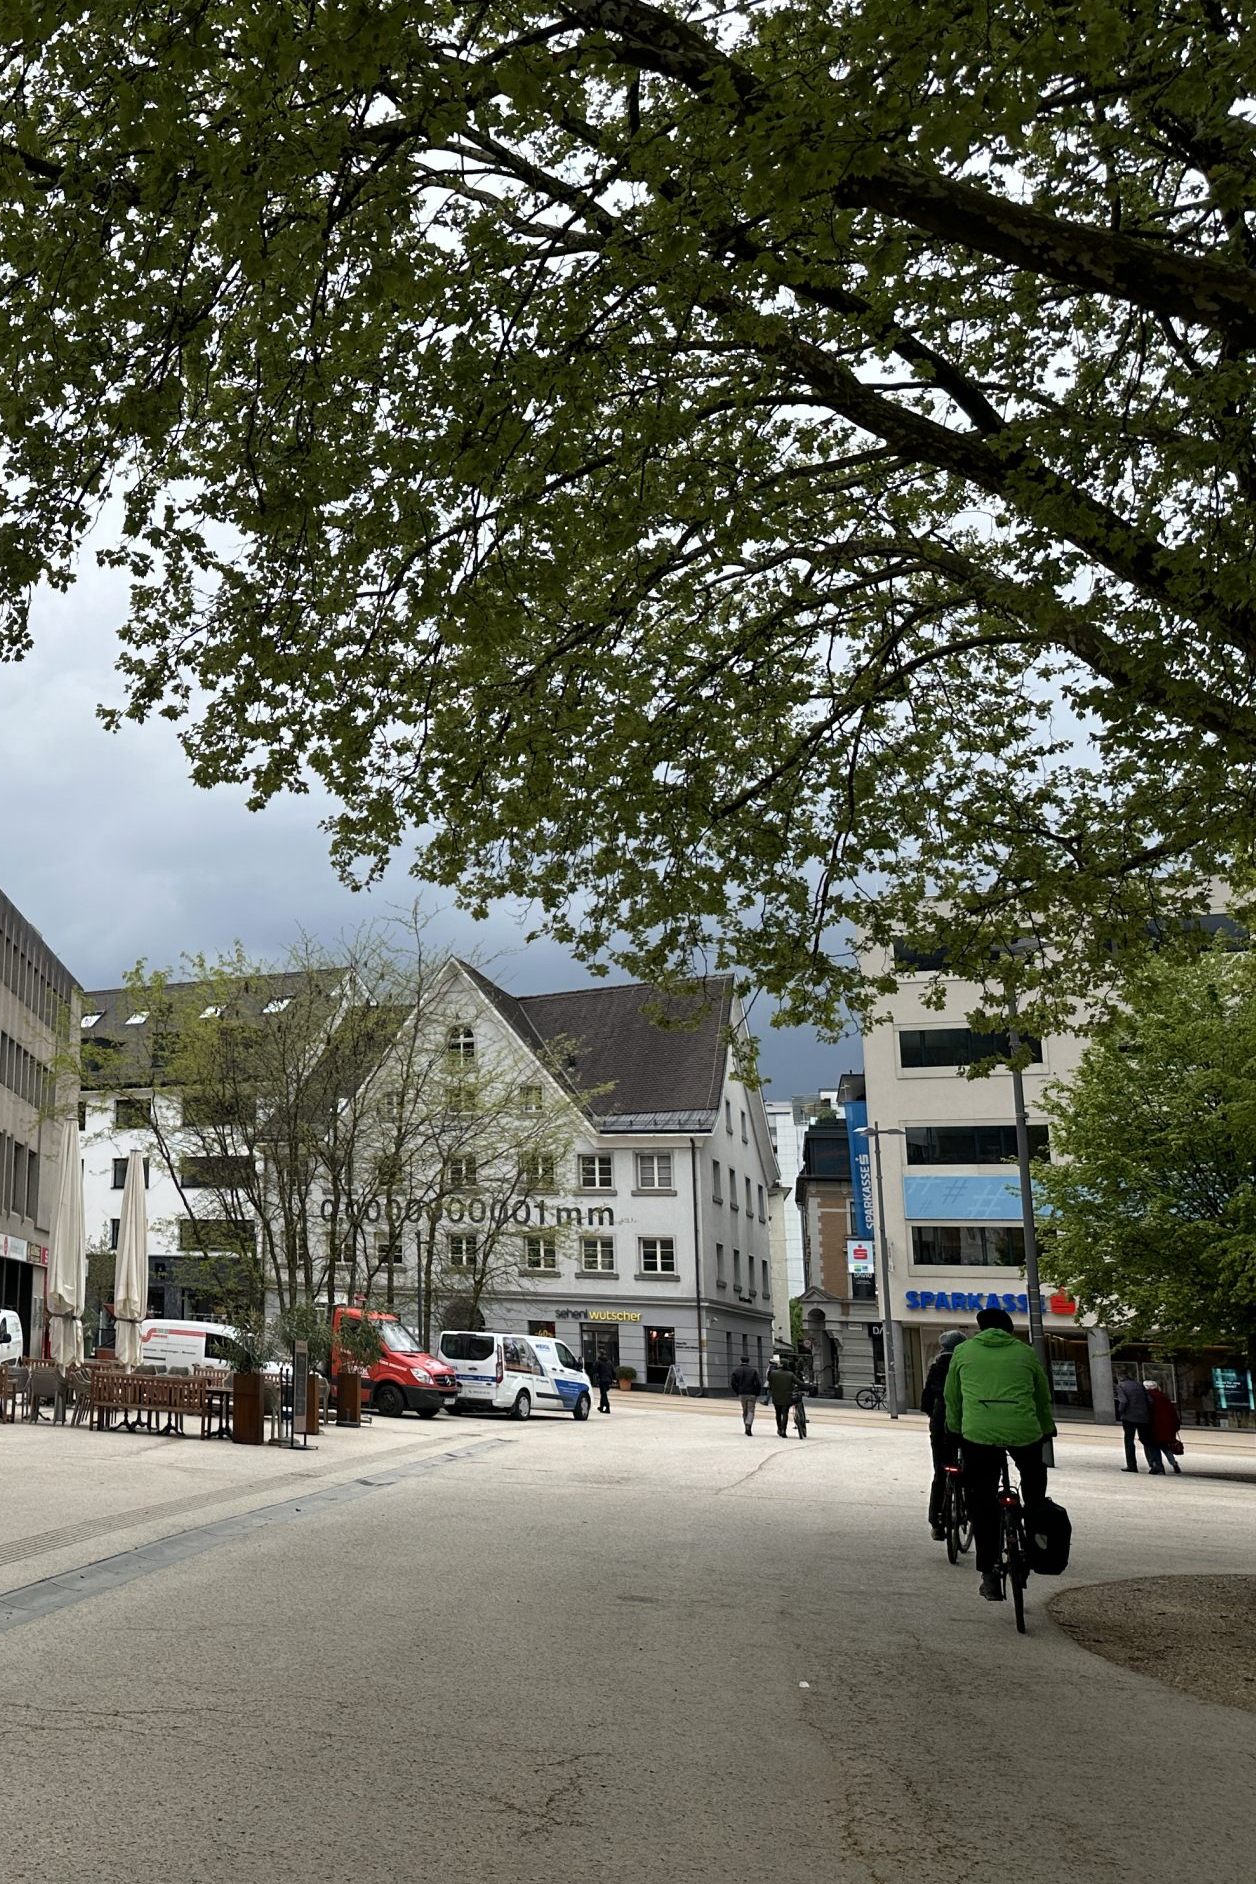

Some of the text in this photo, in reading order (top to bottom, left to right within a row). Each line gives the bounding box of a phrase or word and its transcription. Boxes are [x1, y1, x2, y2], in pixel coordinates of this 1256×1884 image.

[860, 1166, 874, 1230] SPARKASSE
[905, 1290, 1047, 1314] SPARKASS
[589, 1311, 641, 1322] wutscher
